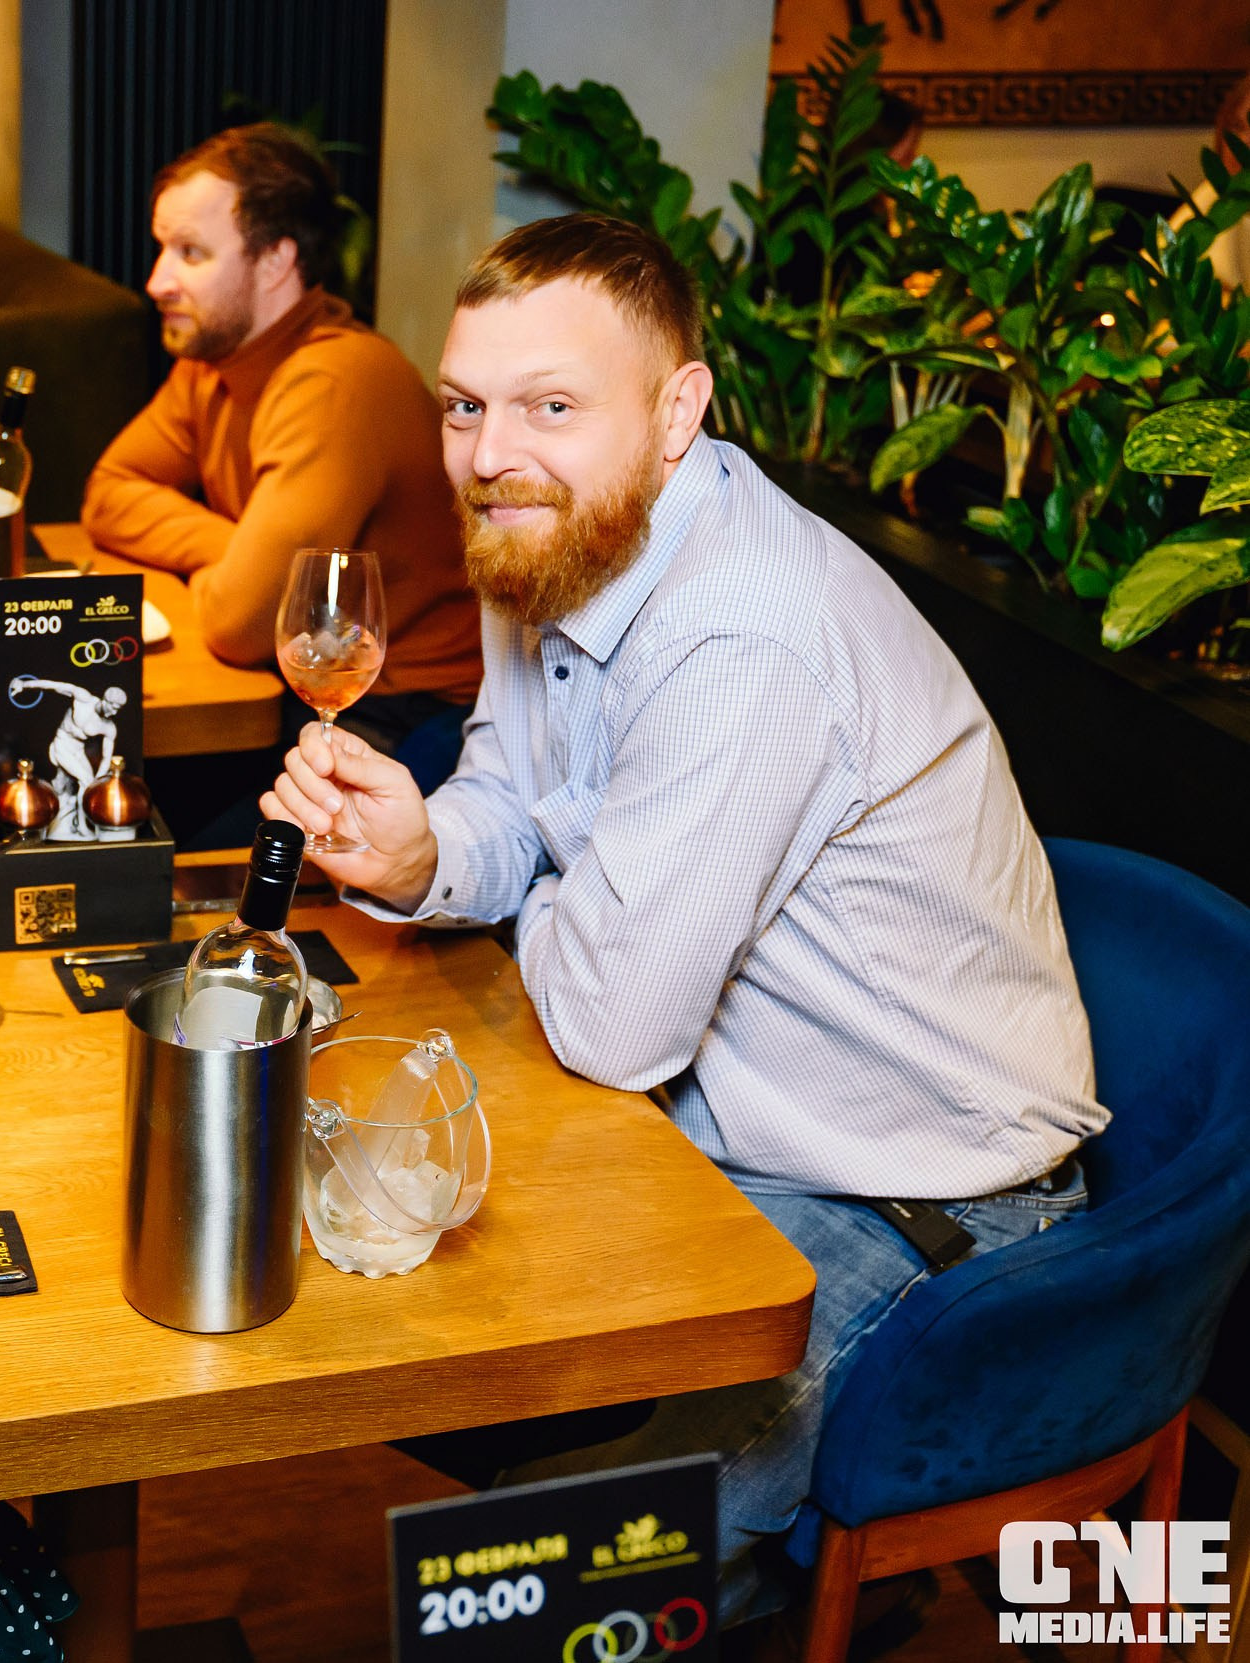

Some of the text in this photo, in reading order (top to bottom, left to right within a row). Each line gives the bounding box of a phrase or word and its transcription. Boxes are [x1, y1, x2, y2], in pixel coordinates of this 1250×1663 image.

[4, 599, 73, 613] 23 ФЕВРАЛЯ
[4, 615, 62, 636] 20:00
[419, 1573, 546, 1635] 20:00
